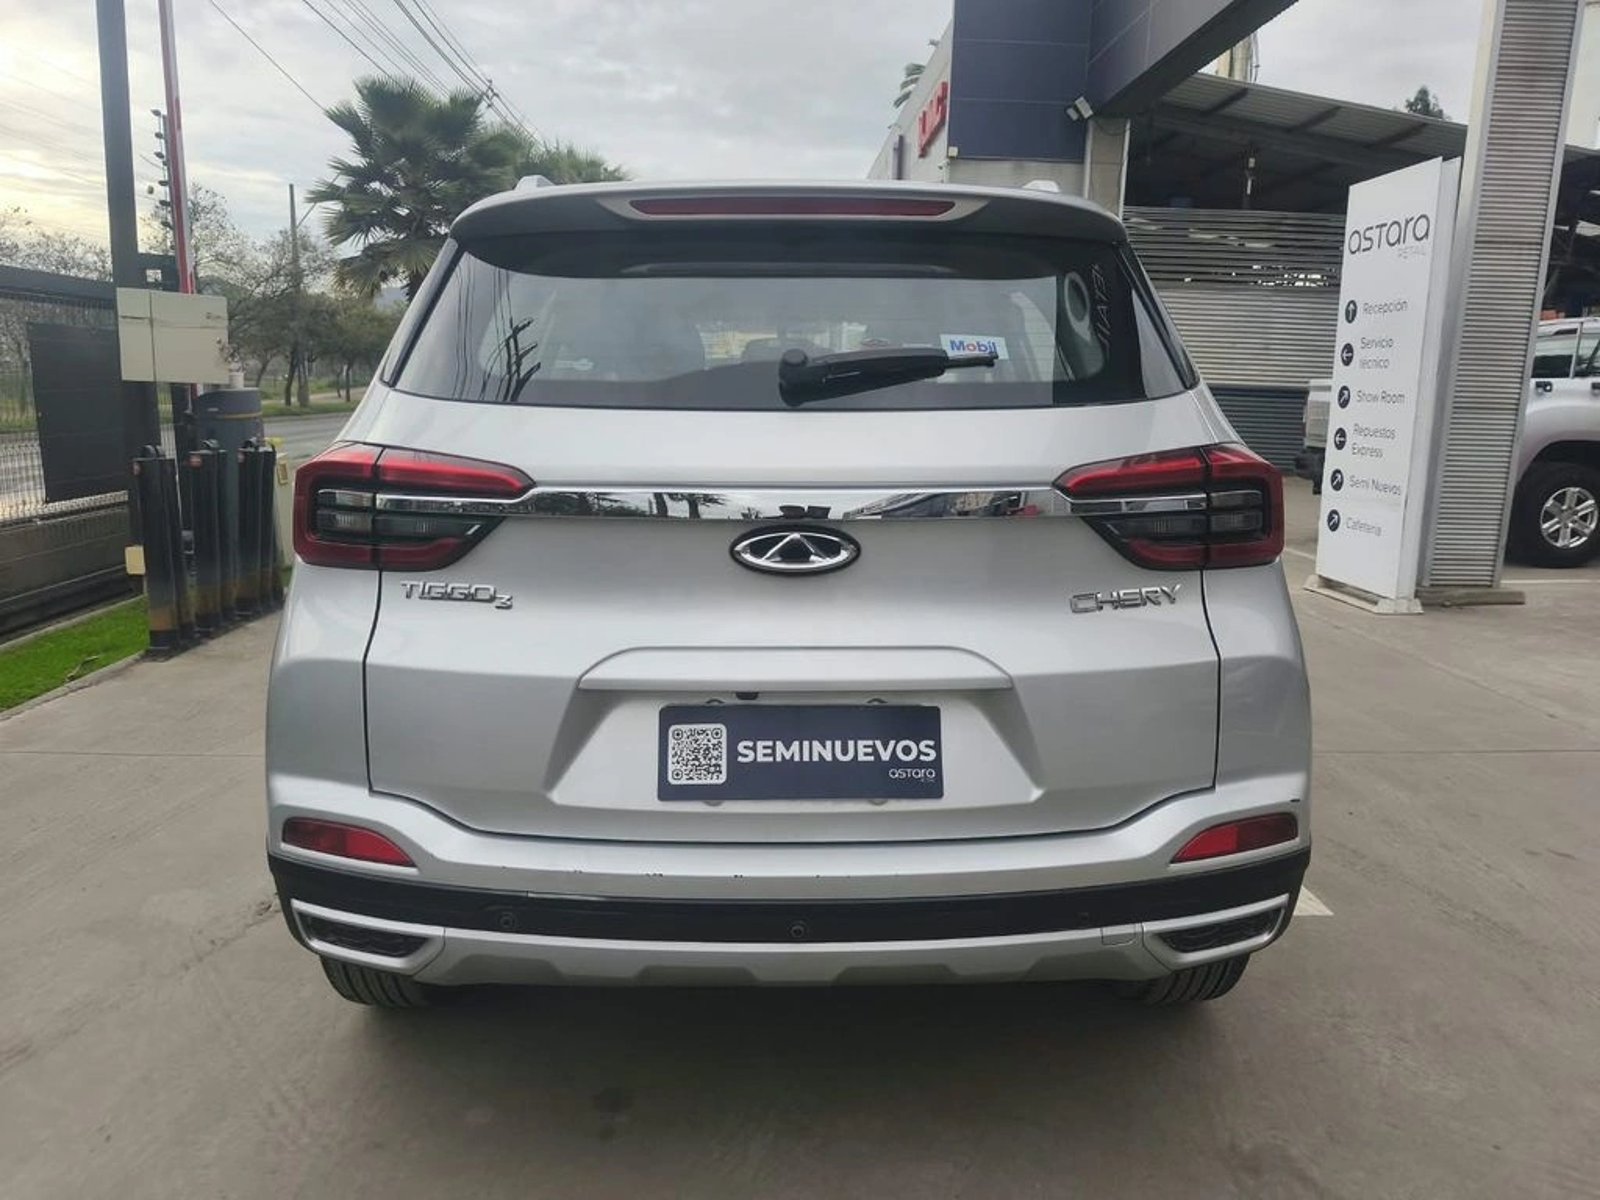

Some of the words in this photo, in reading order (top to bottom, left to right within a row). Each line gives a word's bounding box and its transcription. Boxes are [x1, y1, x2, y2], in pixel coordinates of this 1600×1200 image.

[1348, 214, 1431, 255] astara
[950, 339, 997, 352] Mobil
[1381, 390, 1405, 404] Room
[1069, 584, 1181, 613] CHERY
[737, 739, 937, 763] SEMINUEVOS
[889, 768, 936, 779] astara
